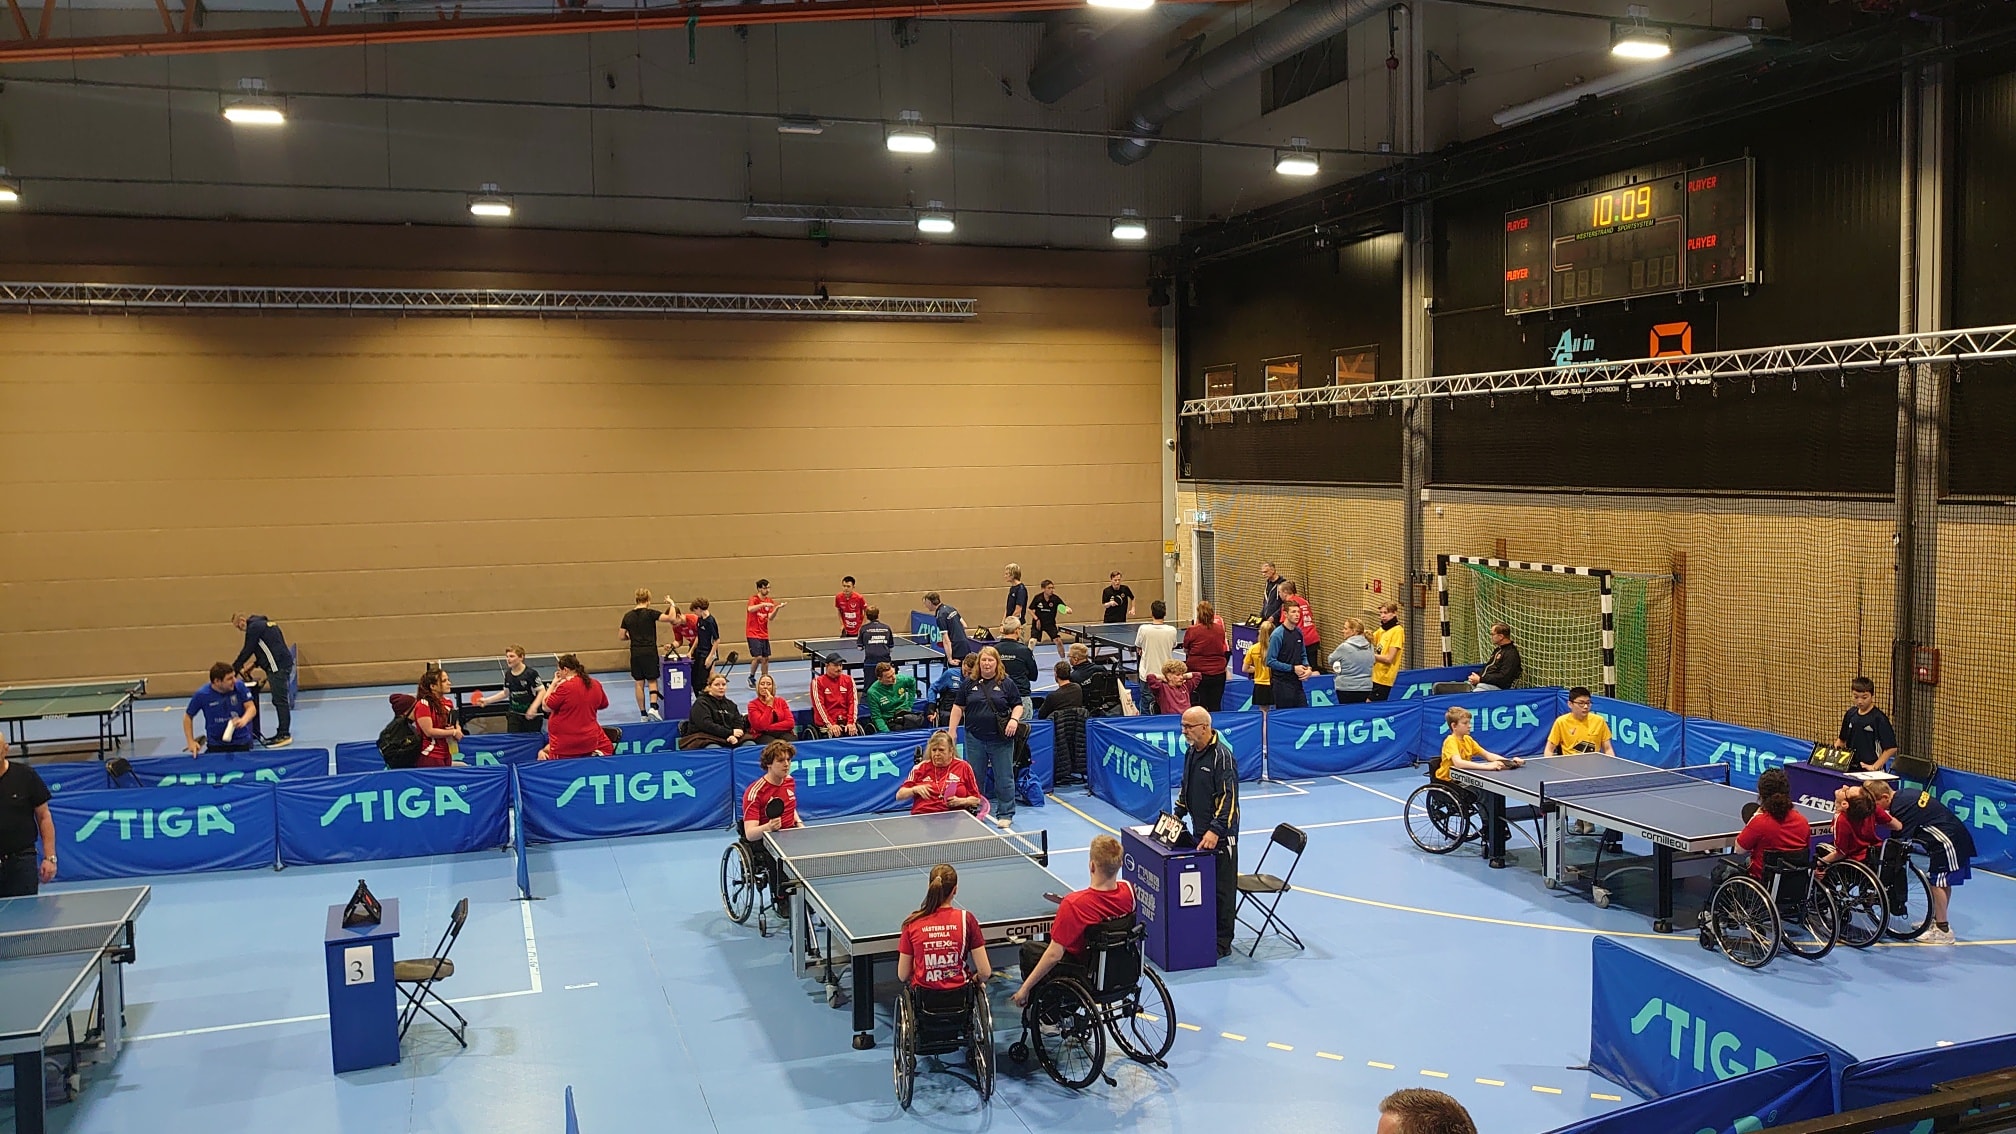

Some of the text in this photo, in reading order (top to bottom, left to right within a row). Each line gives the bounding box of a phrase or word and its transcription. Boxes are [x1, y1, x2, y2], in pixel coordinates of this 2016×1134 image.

[1688, 176, 1716, 192] PLAYER
[1593, 186, 1651, 227] 10:09
[1507, 218, 1528, 232] PLAYER
[1576, 219, 1655, 240] WESTERSTRAND SPORTSYSTEM
[1688, 235, 1716, 249] PLAYER
[1507, 268, 1528, 280] PLAYER
[1583, 334, 1595, 351] in
[1295, 717, 1396, 750] STIGA
[1710, 741, 1798, 775] STIG
[1815, 747, 1826, 760] 4
[1838, 751, 1851, 764] 7
[1102, 744, 1154, 793] STIGA
[556, 770, 696, 808] STIGA
[320, 785, 471, 827] STIGA
[75, 805, 236, 842] STIGA
[1170, 825, 1180, 839] 3
[1641, 829, 1688, 850] cornilleau
[1183, 884, 1196, 903] 2
[1006, 922, 1053, 936] cornill
[351, 961, 364, 981] 3
